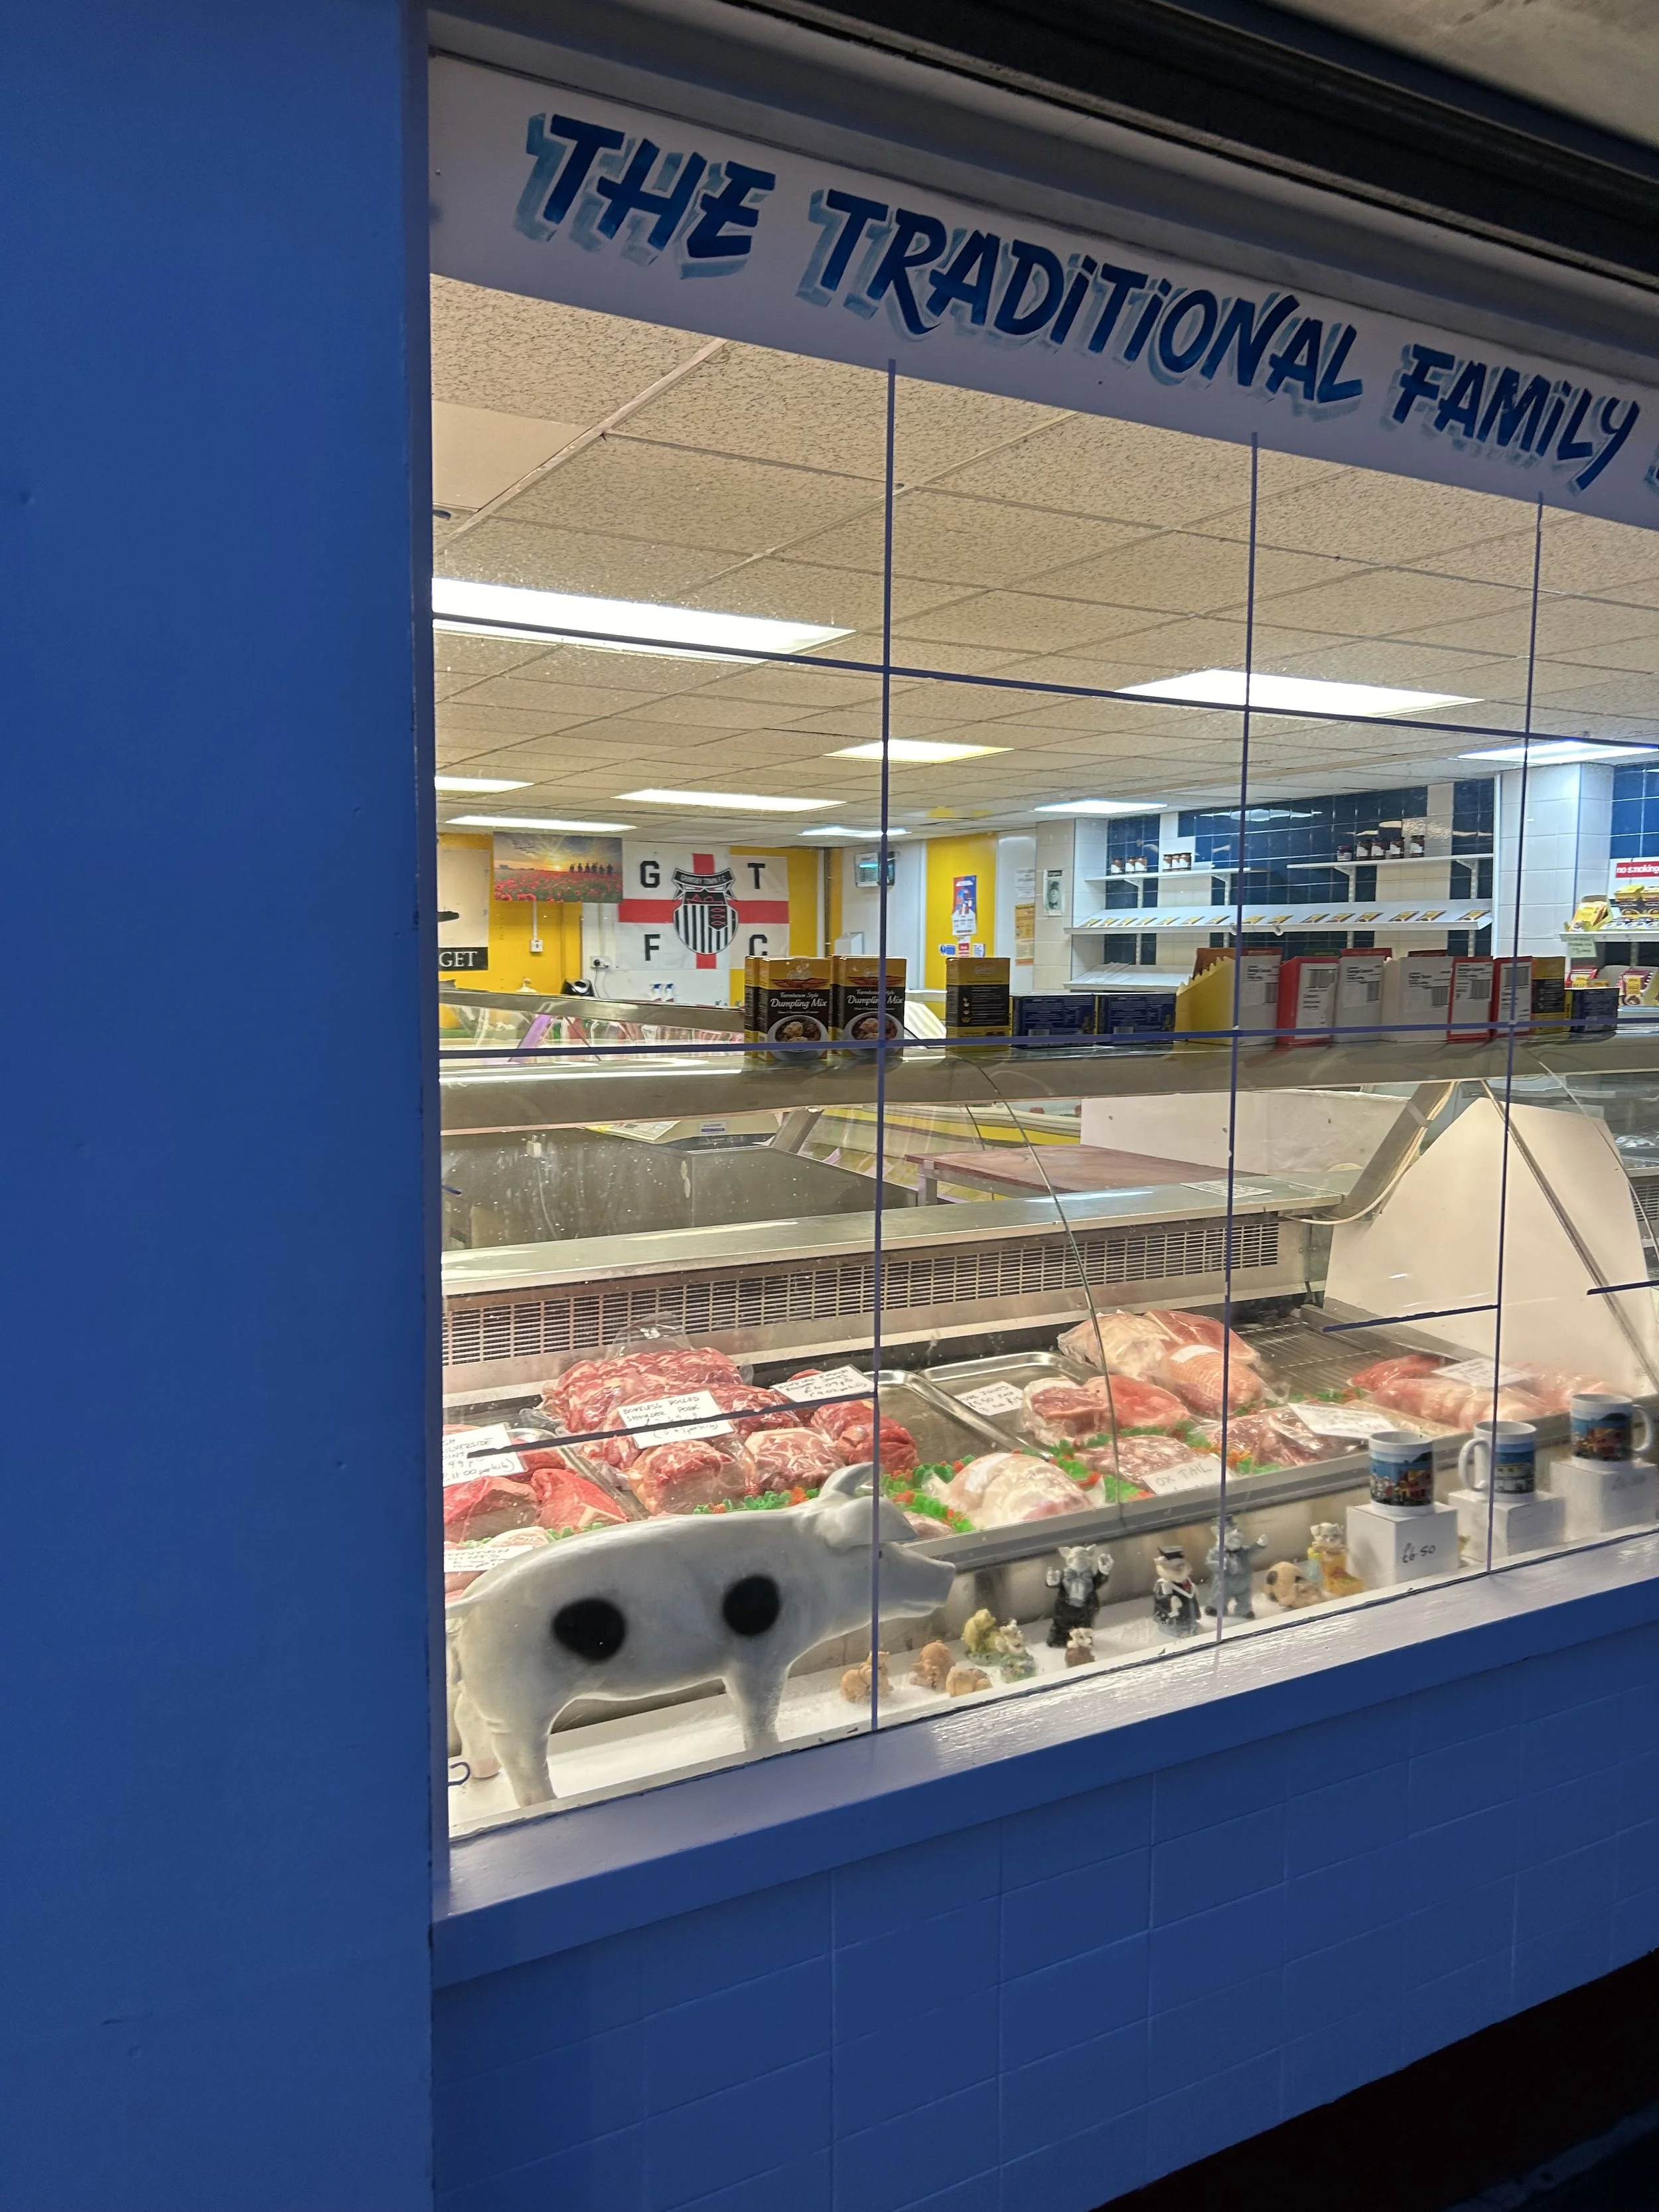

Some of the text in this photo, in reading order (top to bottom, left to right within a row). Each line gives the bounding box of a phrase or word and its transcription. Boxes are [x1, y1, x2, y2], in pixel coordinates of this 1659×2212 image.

[531, 112, 777, 269] THE
[640, 860, 766, 890] G T
[644, 934, 661, 962] F
[770, 997, 828, 1009] Dumpling Mix
[847, 995, 904, 1006] Dumplin Mix
[623, 1395, 700, 1415] BONELESS ROLLED
[1155, 1475, 1176, 1487] OX
[1178, 1461, 1213, 1480] TAIL
